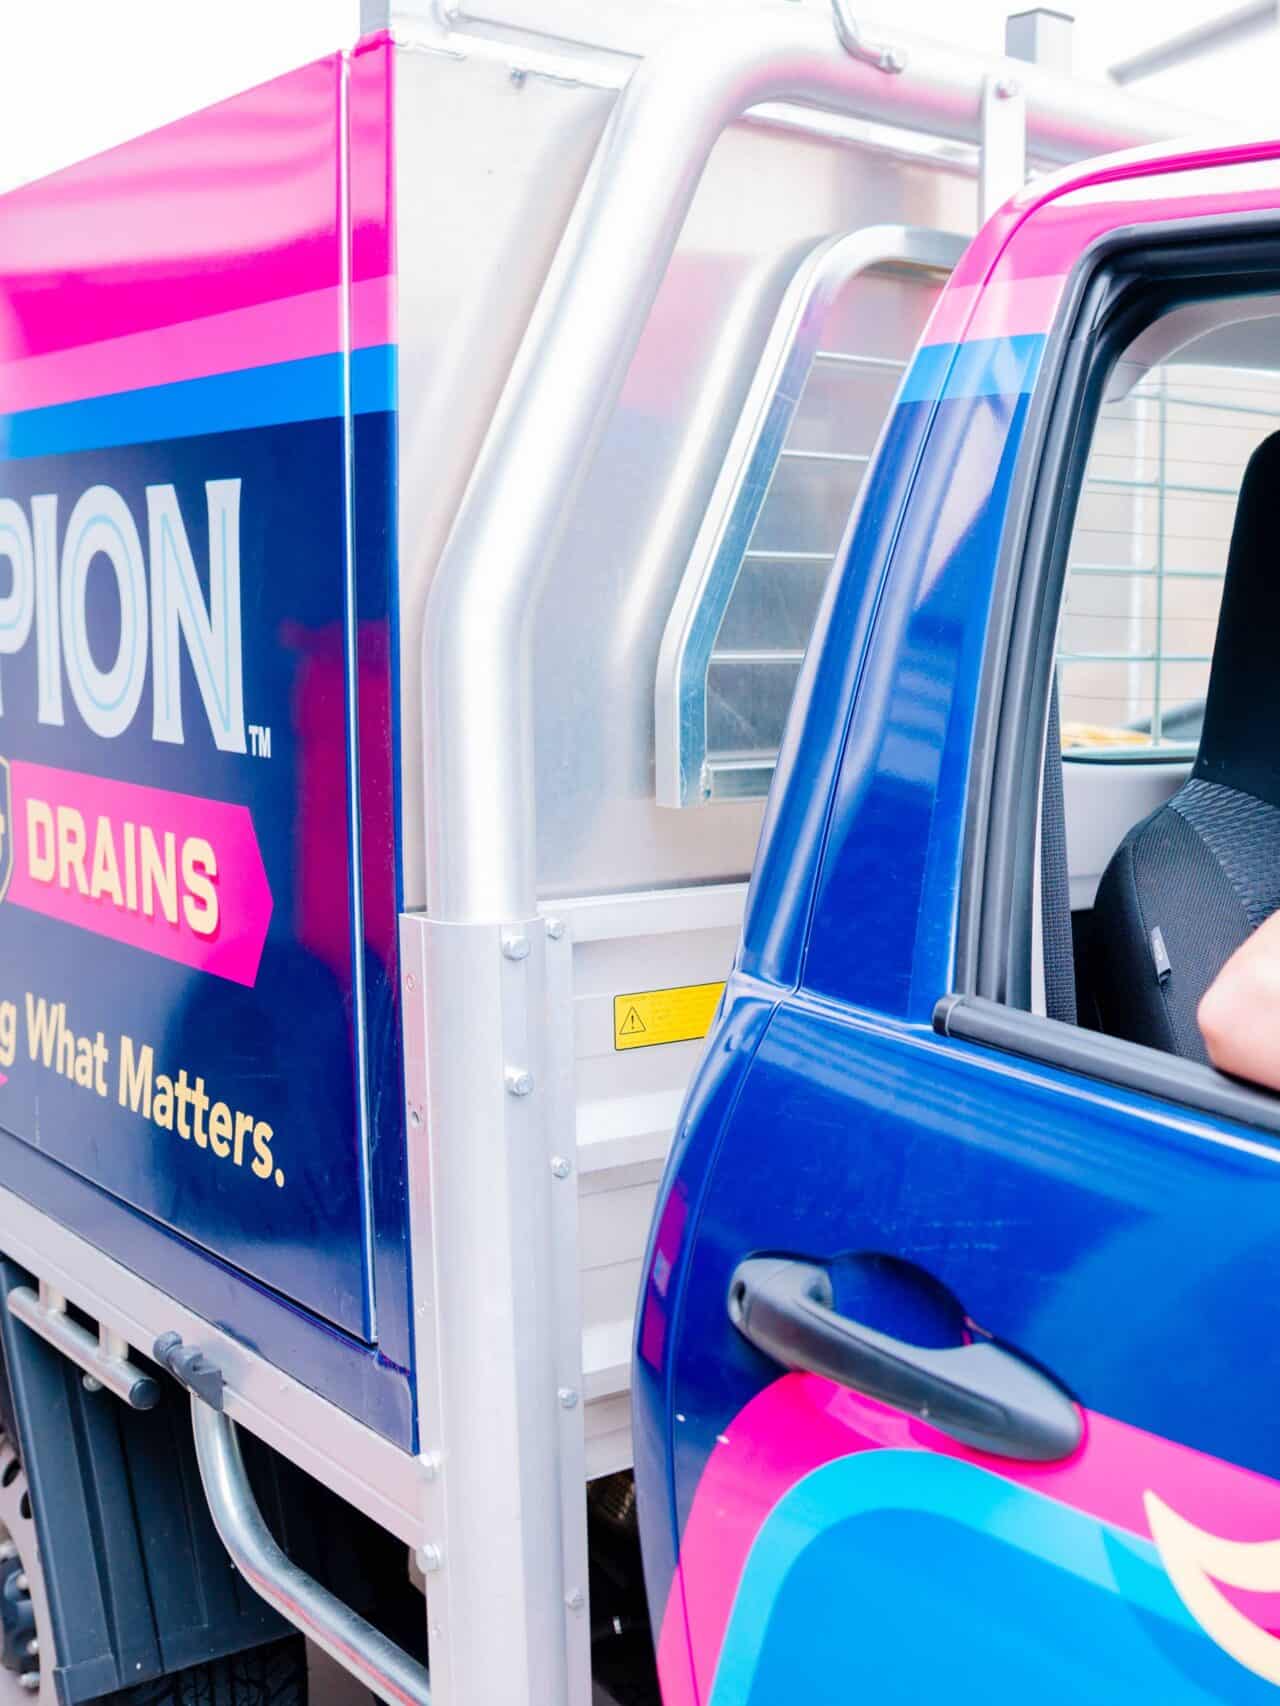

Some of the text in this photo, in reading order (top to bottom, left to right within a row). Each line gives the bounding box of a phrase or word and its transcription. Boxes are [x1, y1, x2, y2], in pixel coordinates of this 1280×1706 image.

[249, 725, 272, 759] TM
[26, 798, 219, 935] DRAINS
[25, 991, 109, 1097] What
[118, 1035, 285, 1188] Matters.
